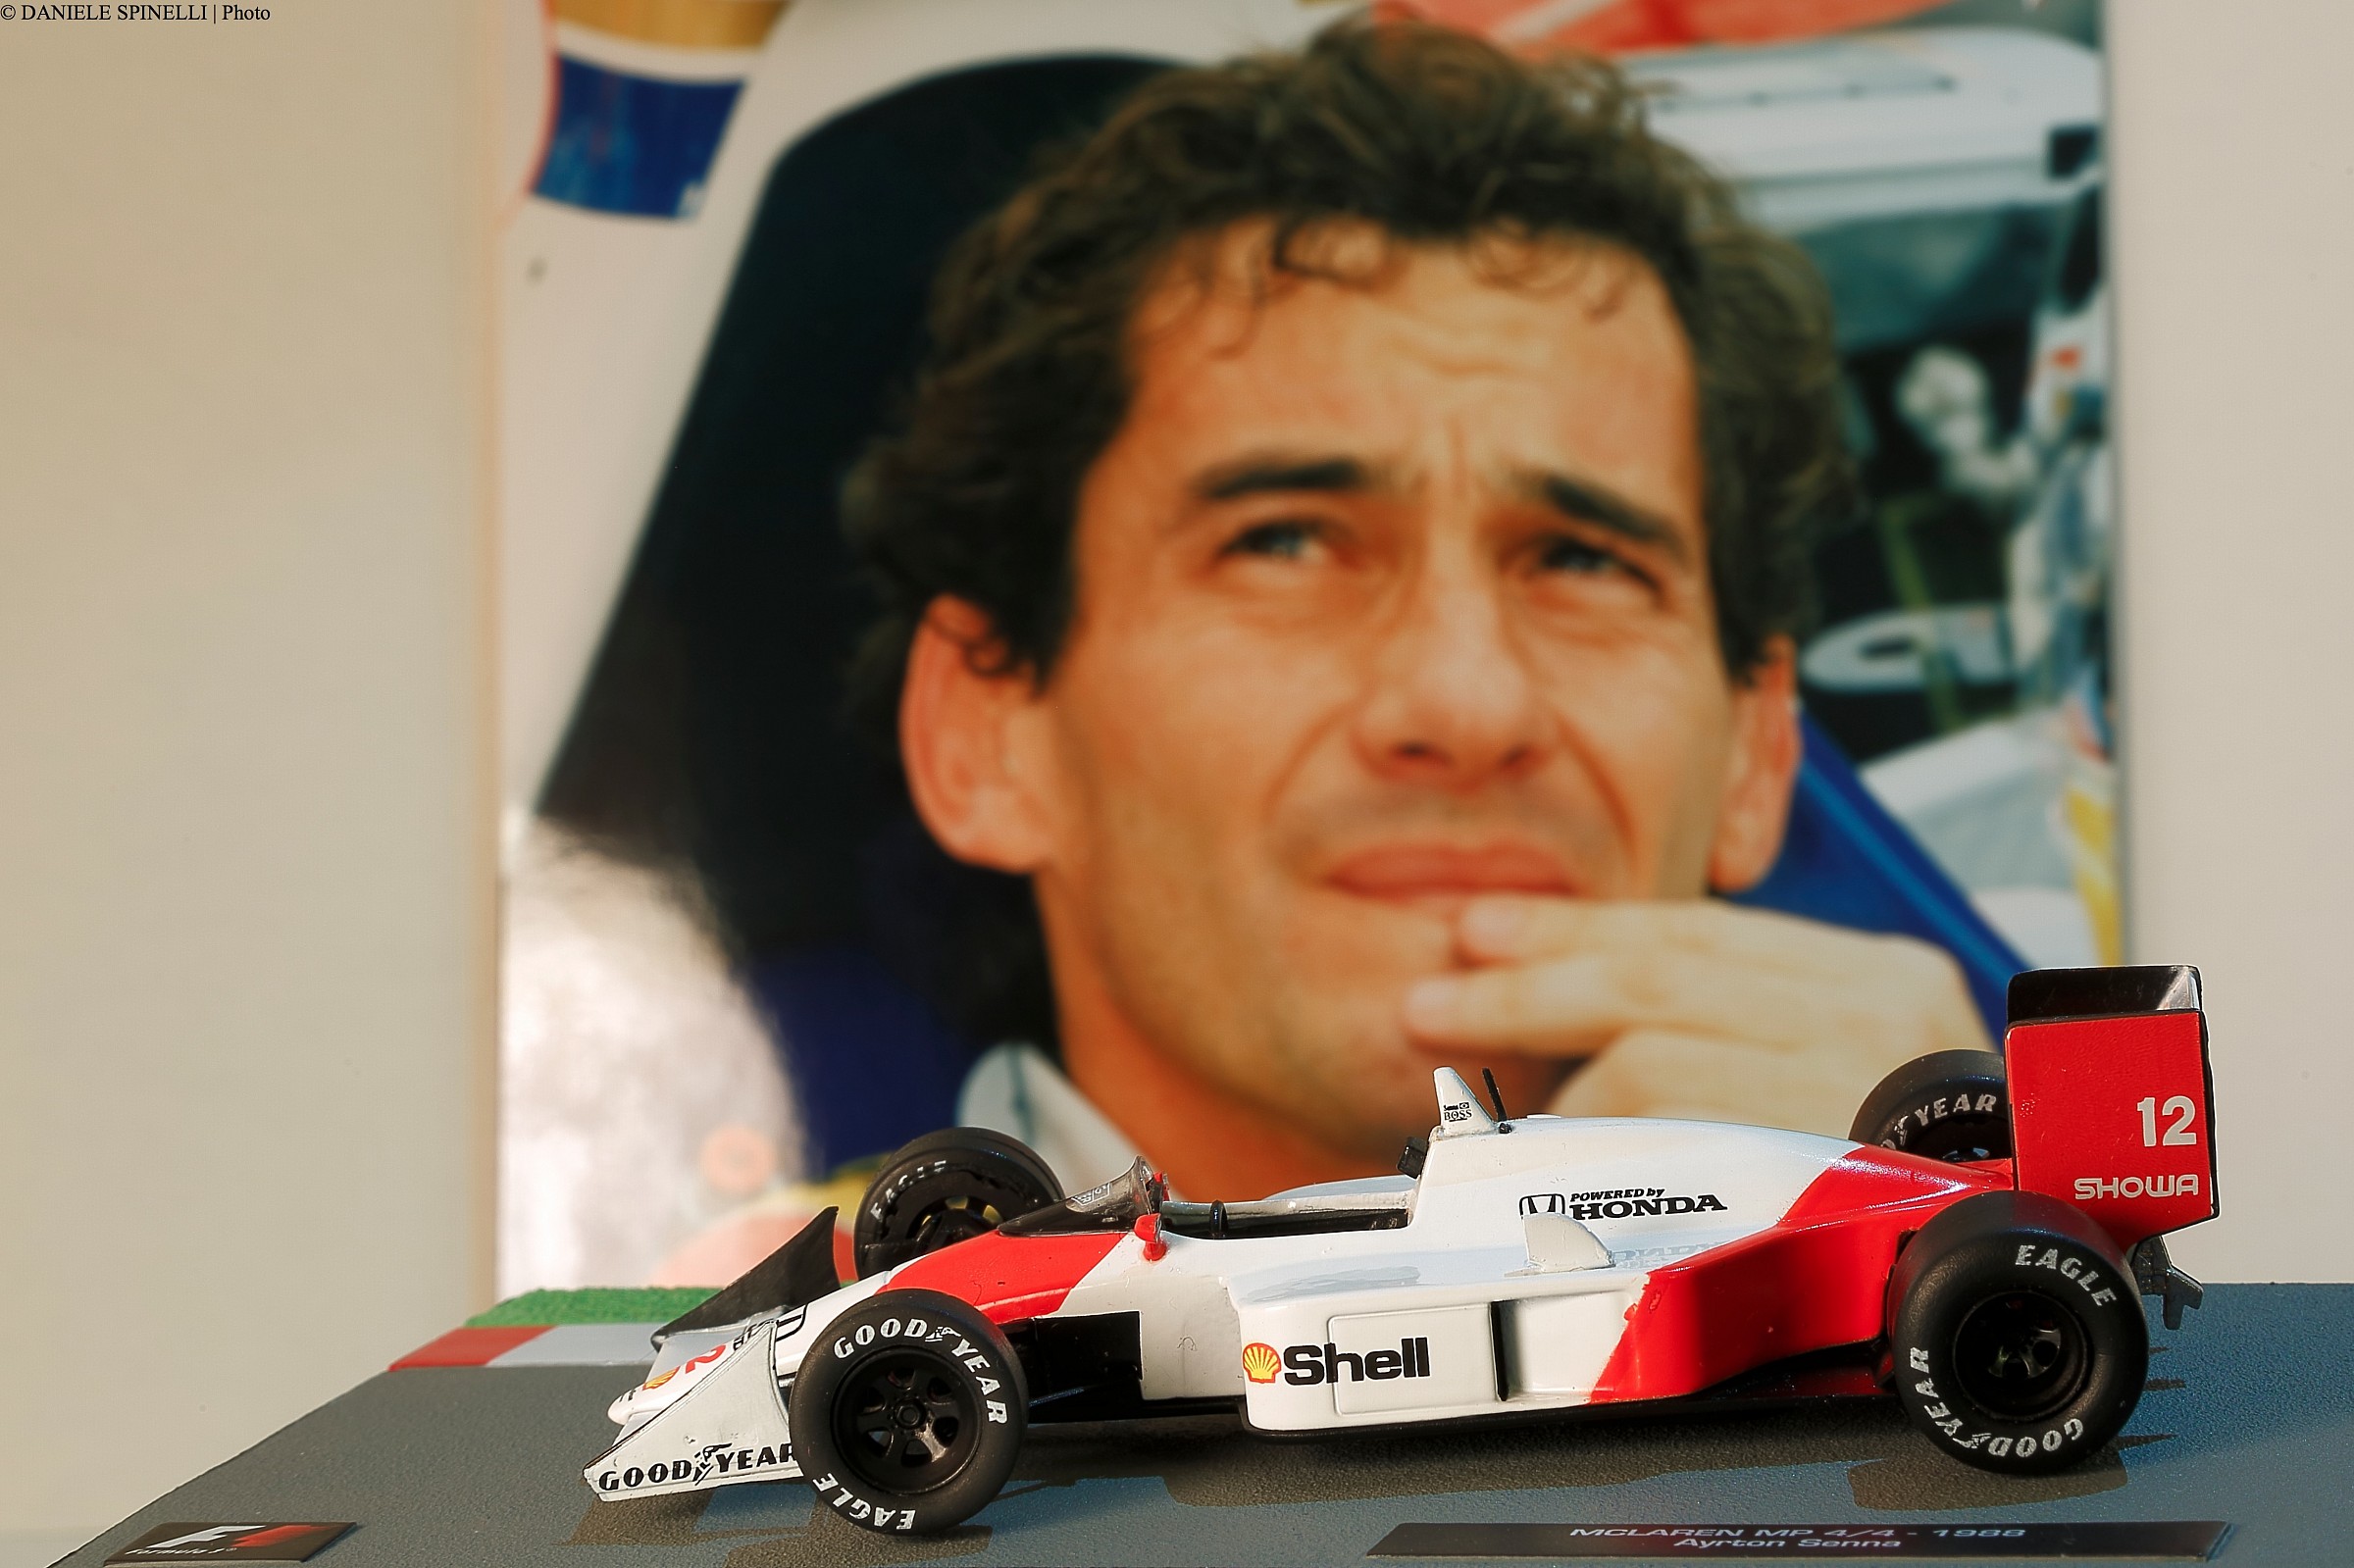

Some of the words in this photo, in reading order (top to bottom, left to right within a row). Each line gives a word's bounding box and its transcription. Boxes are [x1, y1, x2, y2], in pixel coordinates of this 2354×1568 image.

[1444, 1109, 1472, 1121] BOSS
[2137, 1095, 2197, 1147] 12
[1569, 1189, 1645, 1202] POWERED
[1646, 1188, 1665, 1198] by
[2074, 1174, 2199, 1200] SHOWA
[1569, 1194, 1728, 1221] HONDA
[2016, 1244, 2118, 1307] EAGLE
[1283, 1337, 1431, 1386] Shell
[813, 1472, 917, 1530] EAGLE
[1569, 1528, 1744, 1538] MCLAREN
[1754, 1528, 1814, 1538] MP
[1824, 1528, 1896, 1538] 4/4
[1931, 1529, 2026, 1538] 1988
[1673, 1538, 1786, 1549] Ayrton
[1797, 1539, 1902, 1547] Senna
